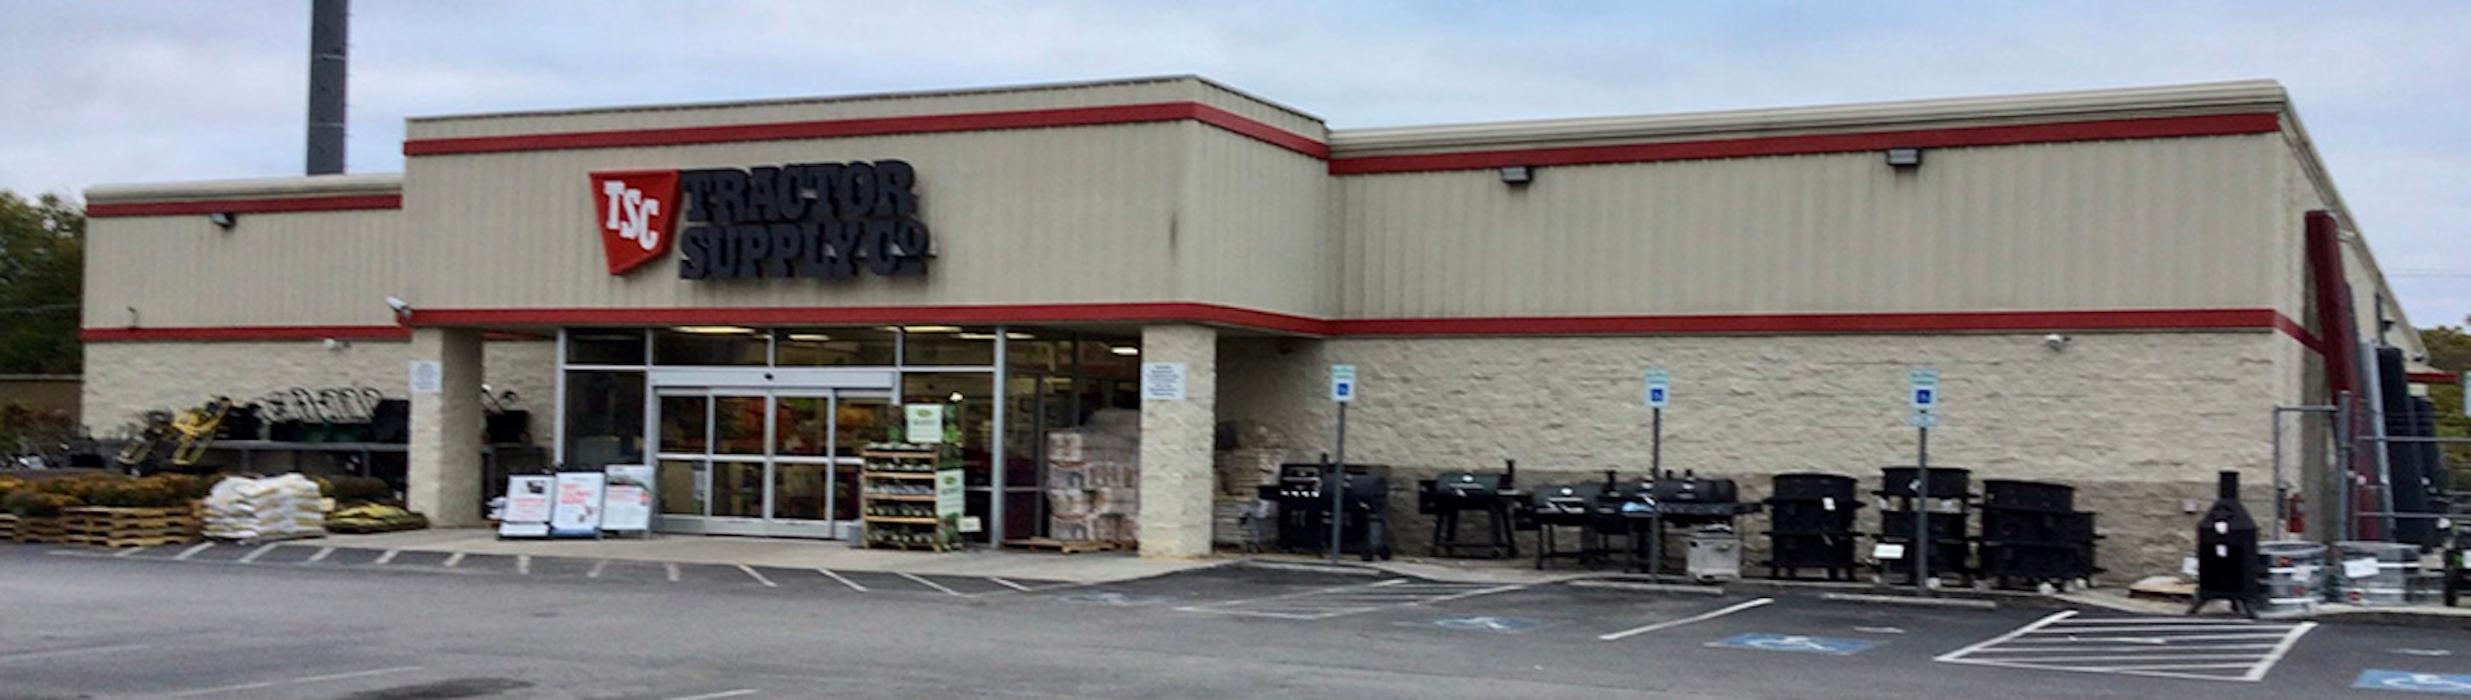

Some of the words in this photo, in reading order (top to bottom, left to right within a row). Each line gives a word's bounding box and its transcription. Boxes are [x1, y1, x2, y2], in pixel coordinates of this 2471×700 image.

[603, 180, 660, 251] TSC
[682, 159, 917, 222] TRACTOR
[679, 221, 863, 280] SUPPLY
